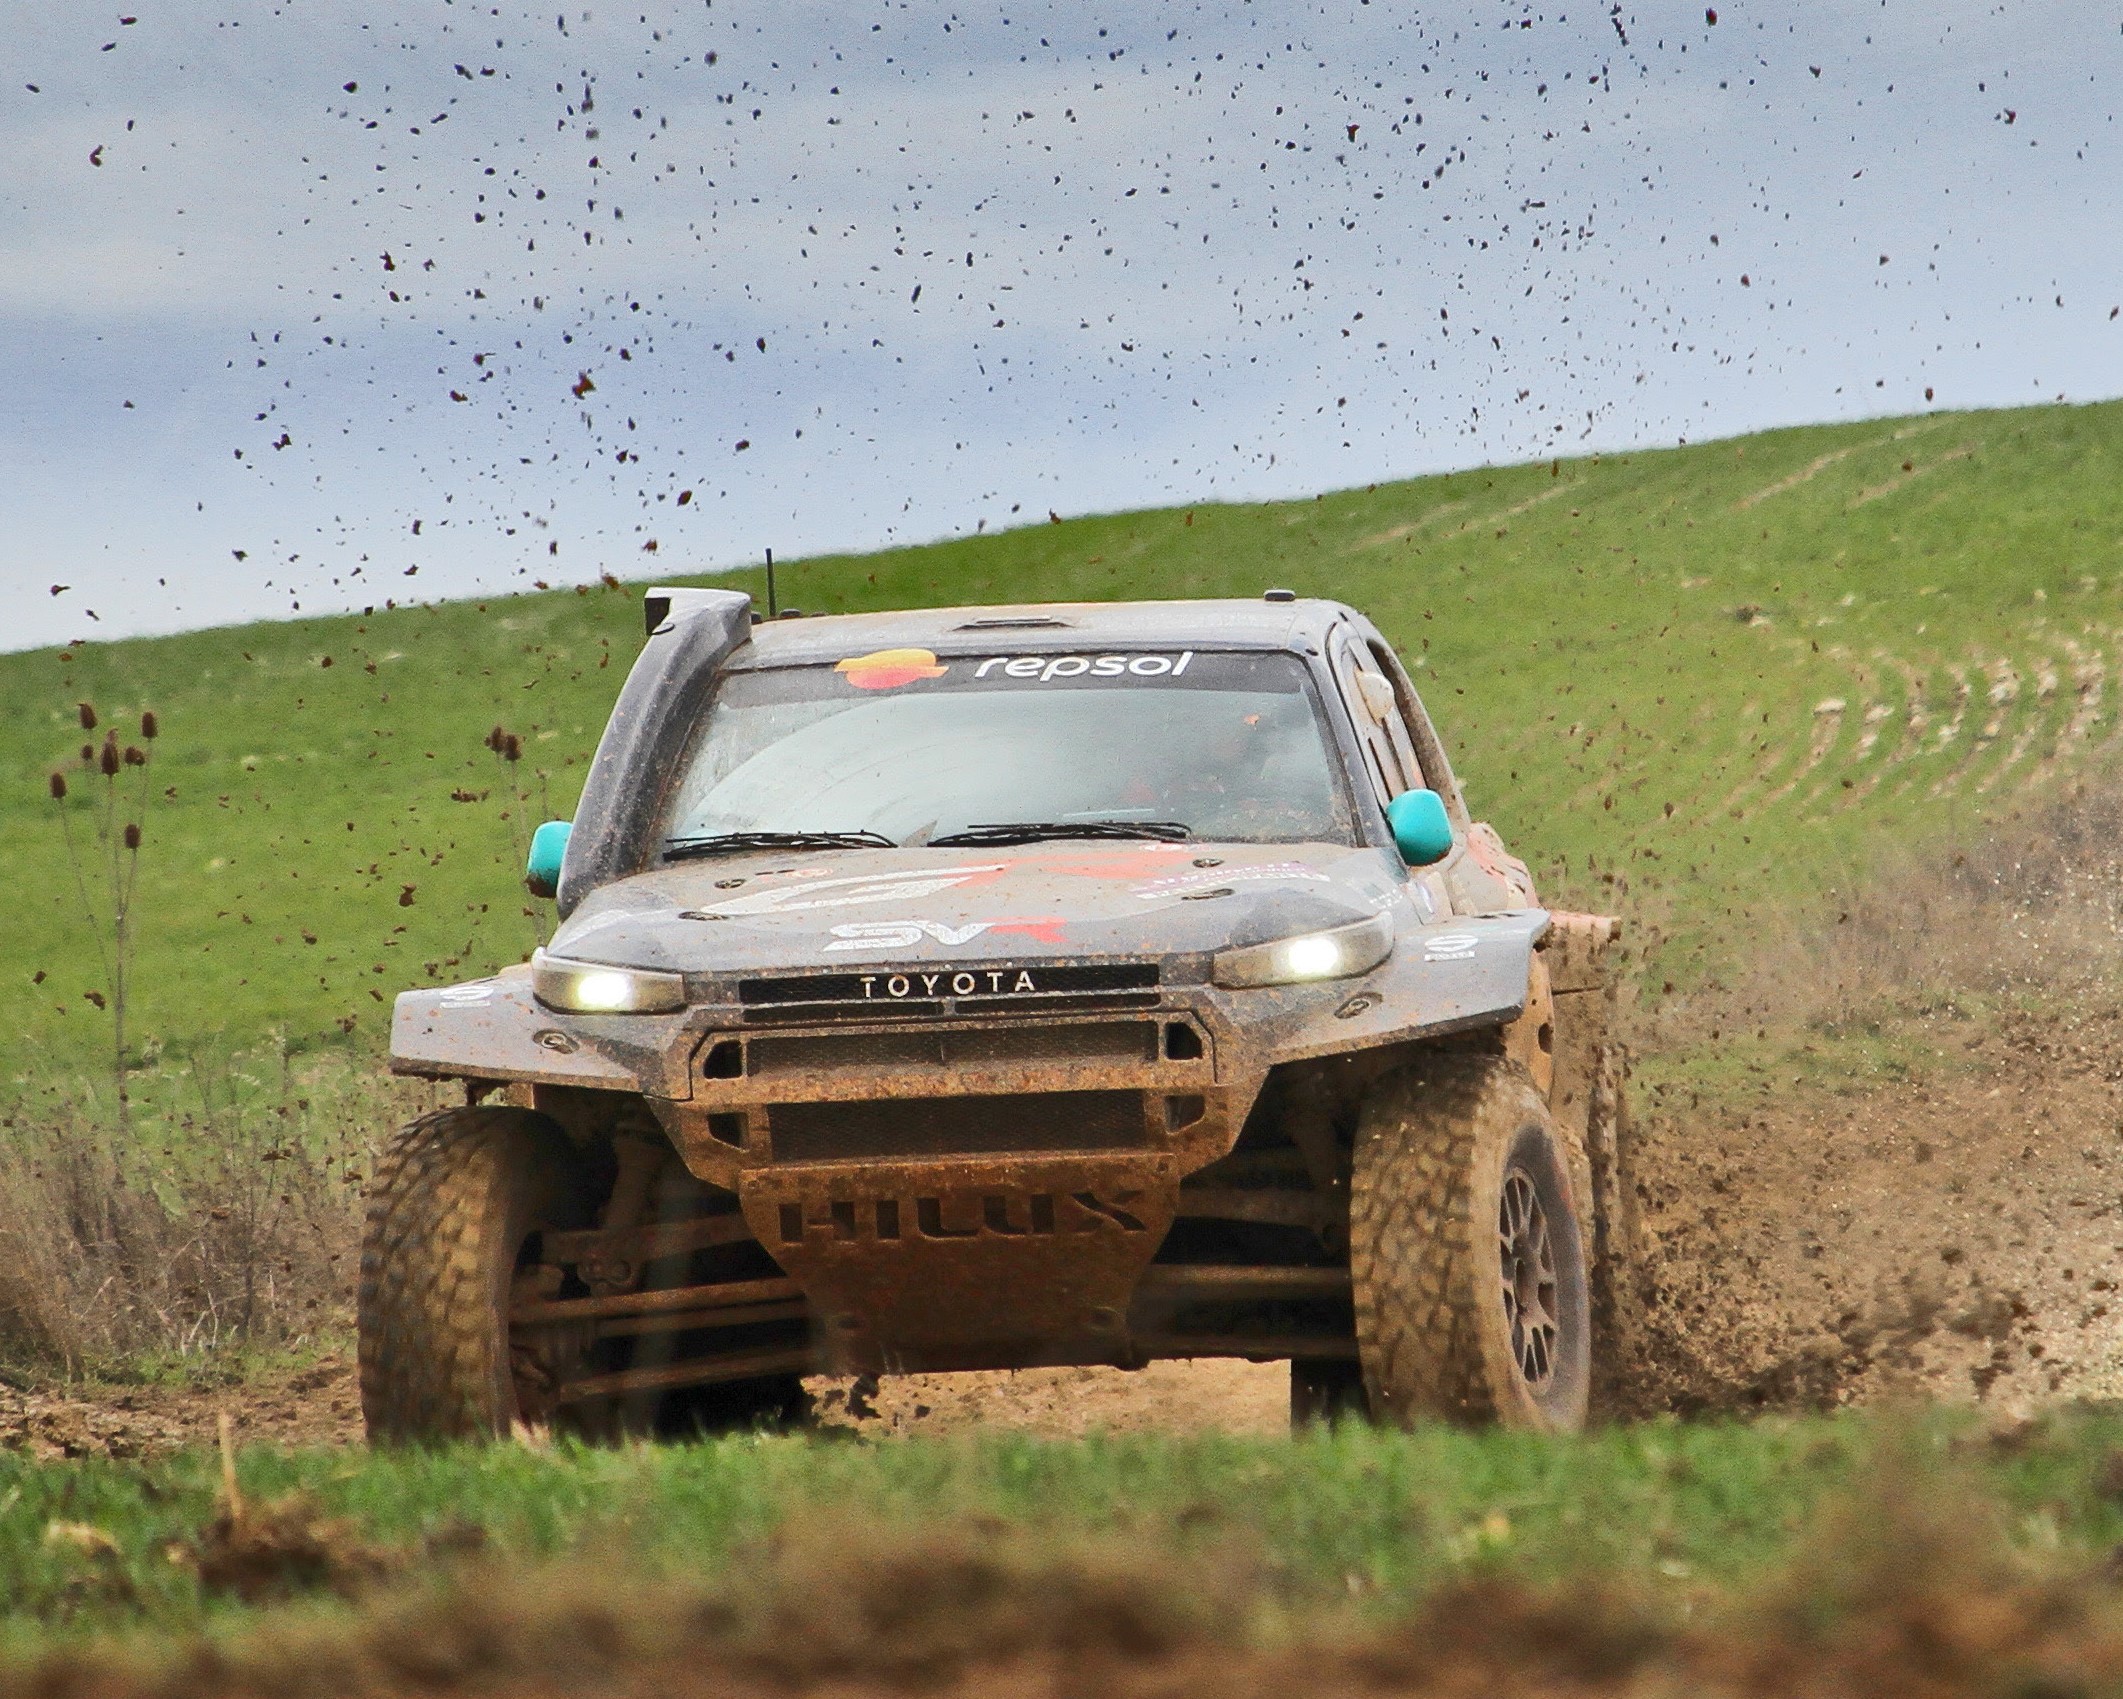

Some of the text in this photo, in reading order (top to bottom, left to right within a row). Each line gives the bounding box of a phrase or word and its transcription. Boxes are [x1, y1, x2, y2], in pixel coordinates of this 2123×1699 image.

[975, 652, 1193, 682] repsol
[860, 971, 1035, 998] TOYOTA
[778, 1191, 1147, 1244] HILUX
